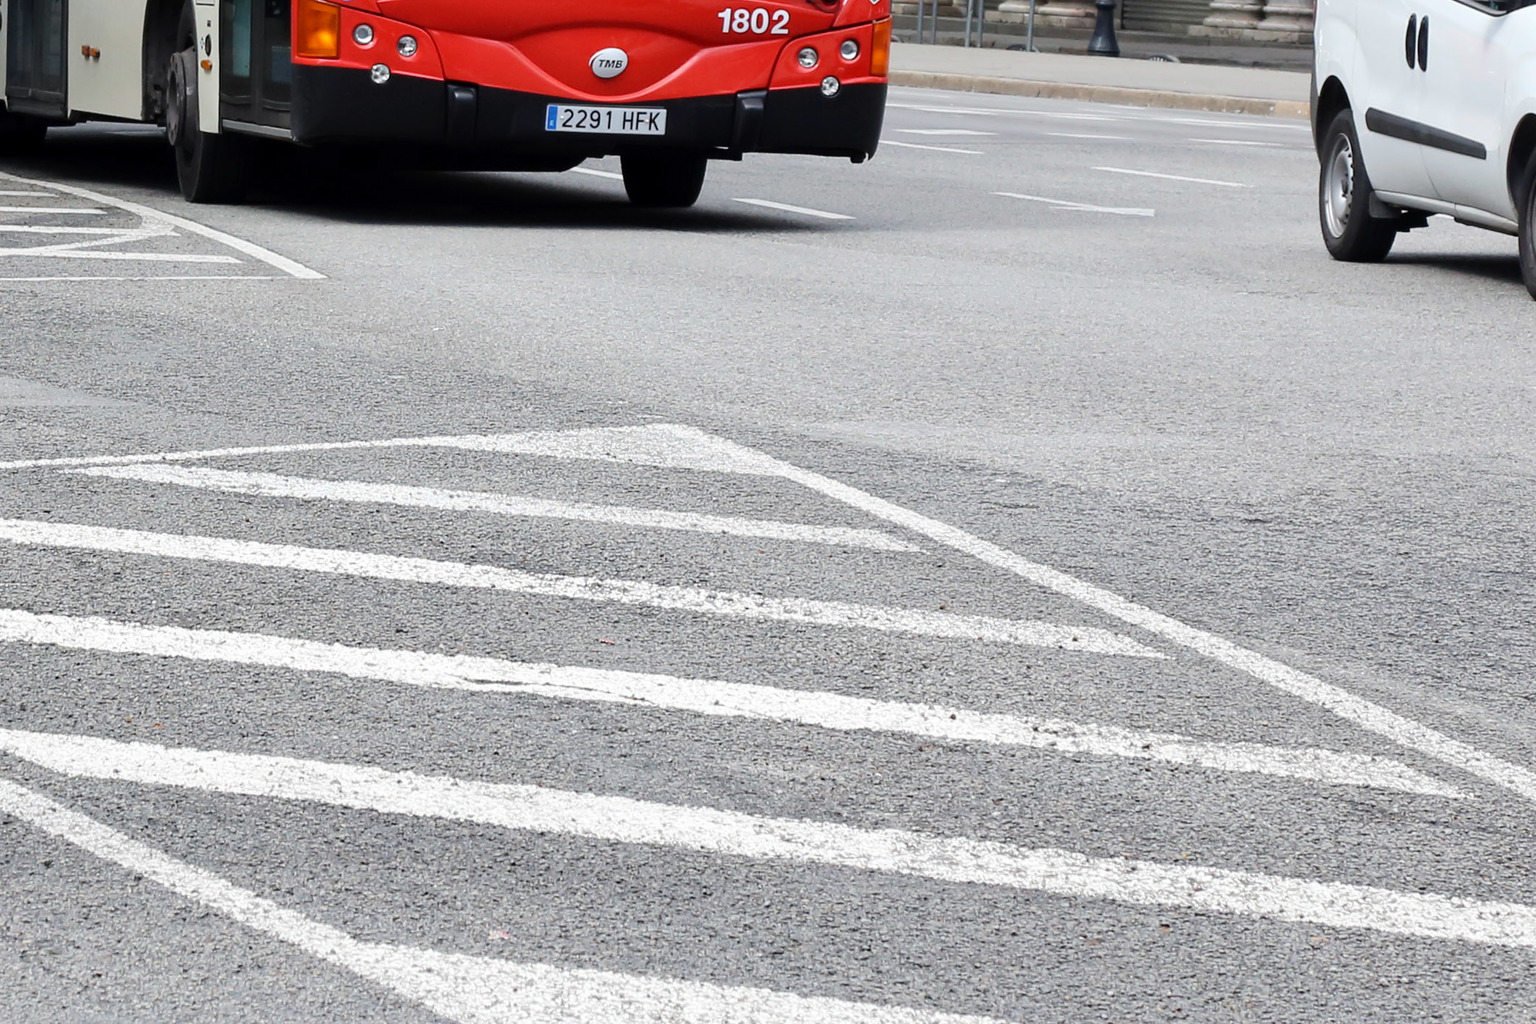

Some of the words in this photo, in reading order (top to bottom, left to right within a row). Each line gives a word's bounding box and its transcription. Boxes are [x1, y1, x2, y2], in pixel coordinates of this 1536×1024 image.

[718, 8, 790, 35] 1802
[599, 59, 624, 69] TMB
[562, 109, 612, 129] 2291
[622, 112, 660, 131] HFK
